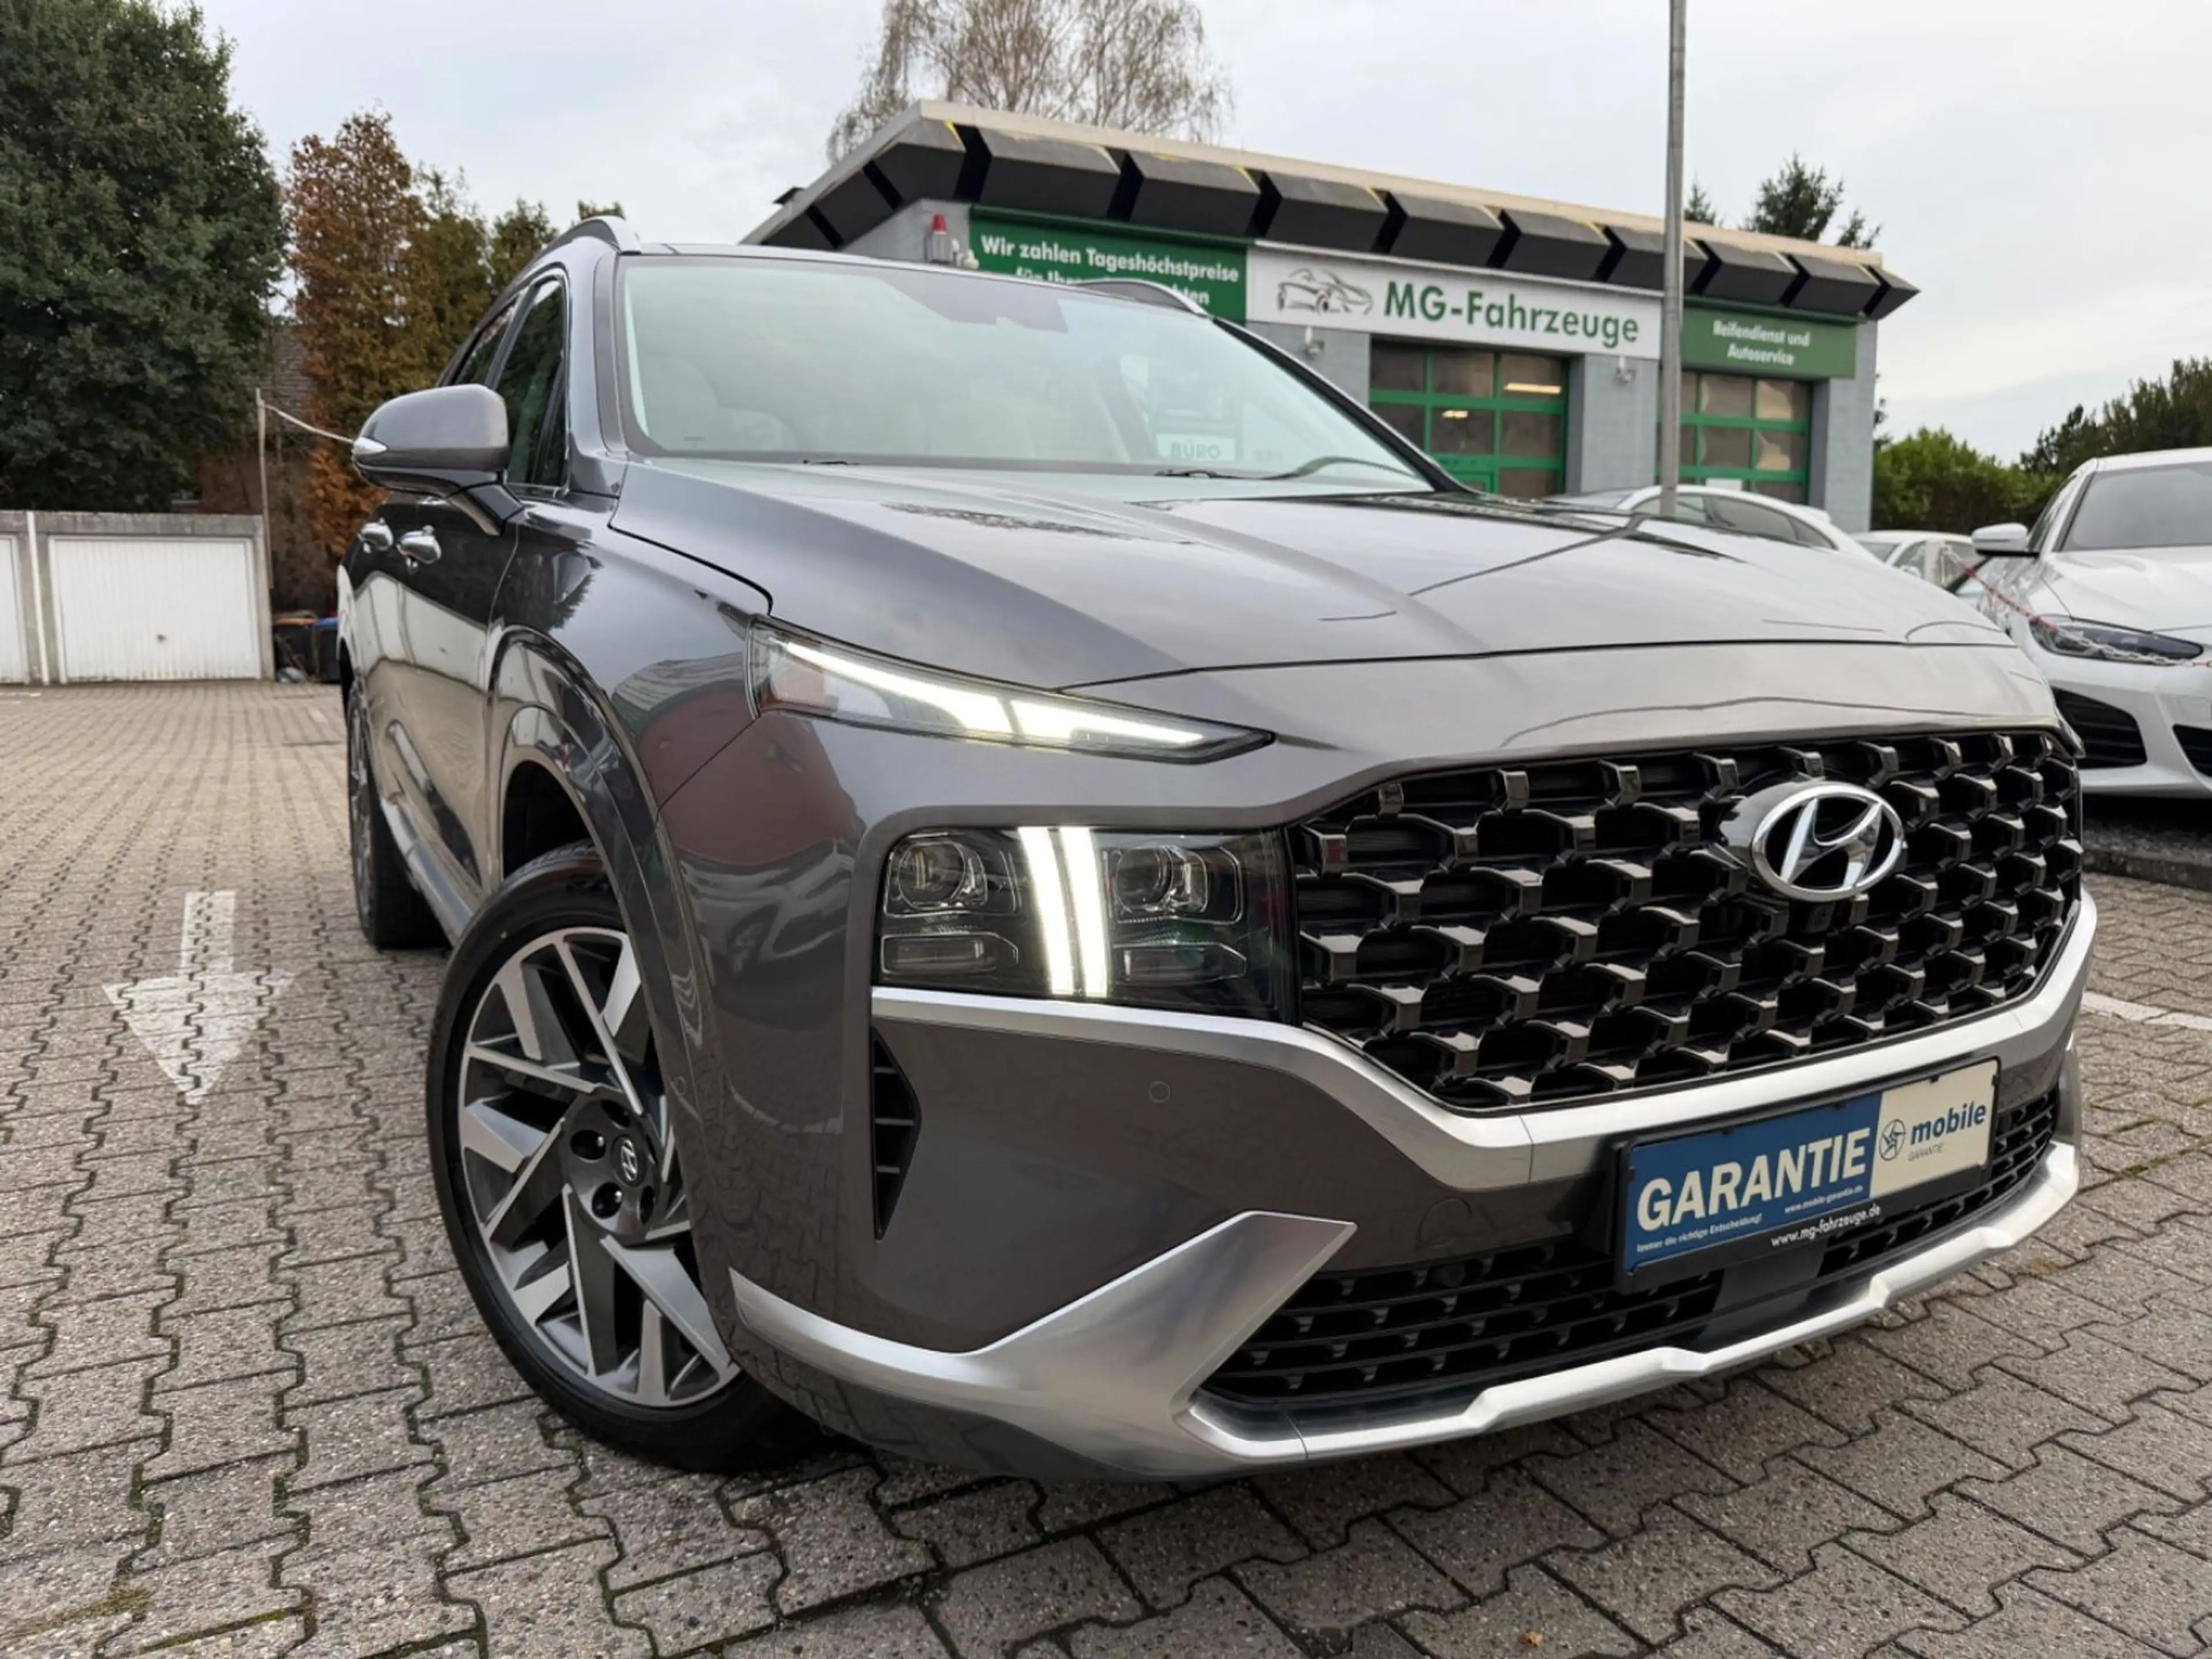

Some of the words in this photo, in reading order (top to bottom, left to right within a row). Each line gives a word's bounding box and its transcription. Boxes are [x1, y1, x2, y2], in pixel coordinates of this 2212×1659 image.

[980, 235, 1015, 256] Wir
[1019, 241, 1081, 264] zahlen
[1085, 246, 1239, 282] Tageshöchstpreise
[1384, 281, 1639, 349] MG-Fahrzeuge
[1713, 320, 1786, 344] Reifendienst
[1787, 332, 1810, 347] und
[1727, 343, 1795, 366] Autoservice
[1911, 1100, 1986, 1145] mobile
[1637, 1127, 1871, 1232] GARANTIE
[1637, 1241, 1663, 1252] Immer
[1664, 1236, 1677, 1246] die
[1678, 1229, 1708, 1242] richtige
[1771, 1202, 1881, 1247] www.mg-fahrzeuge.de
